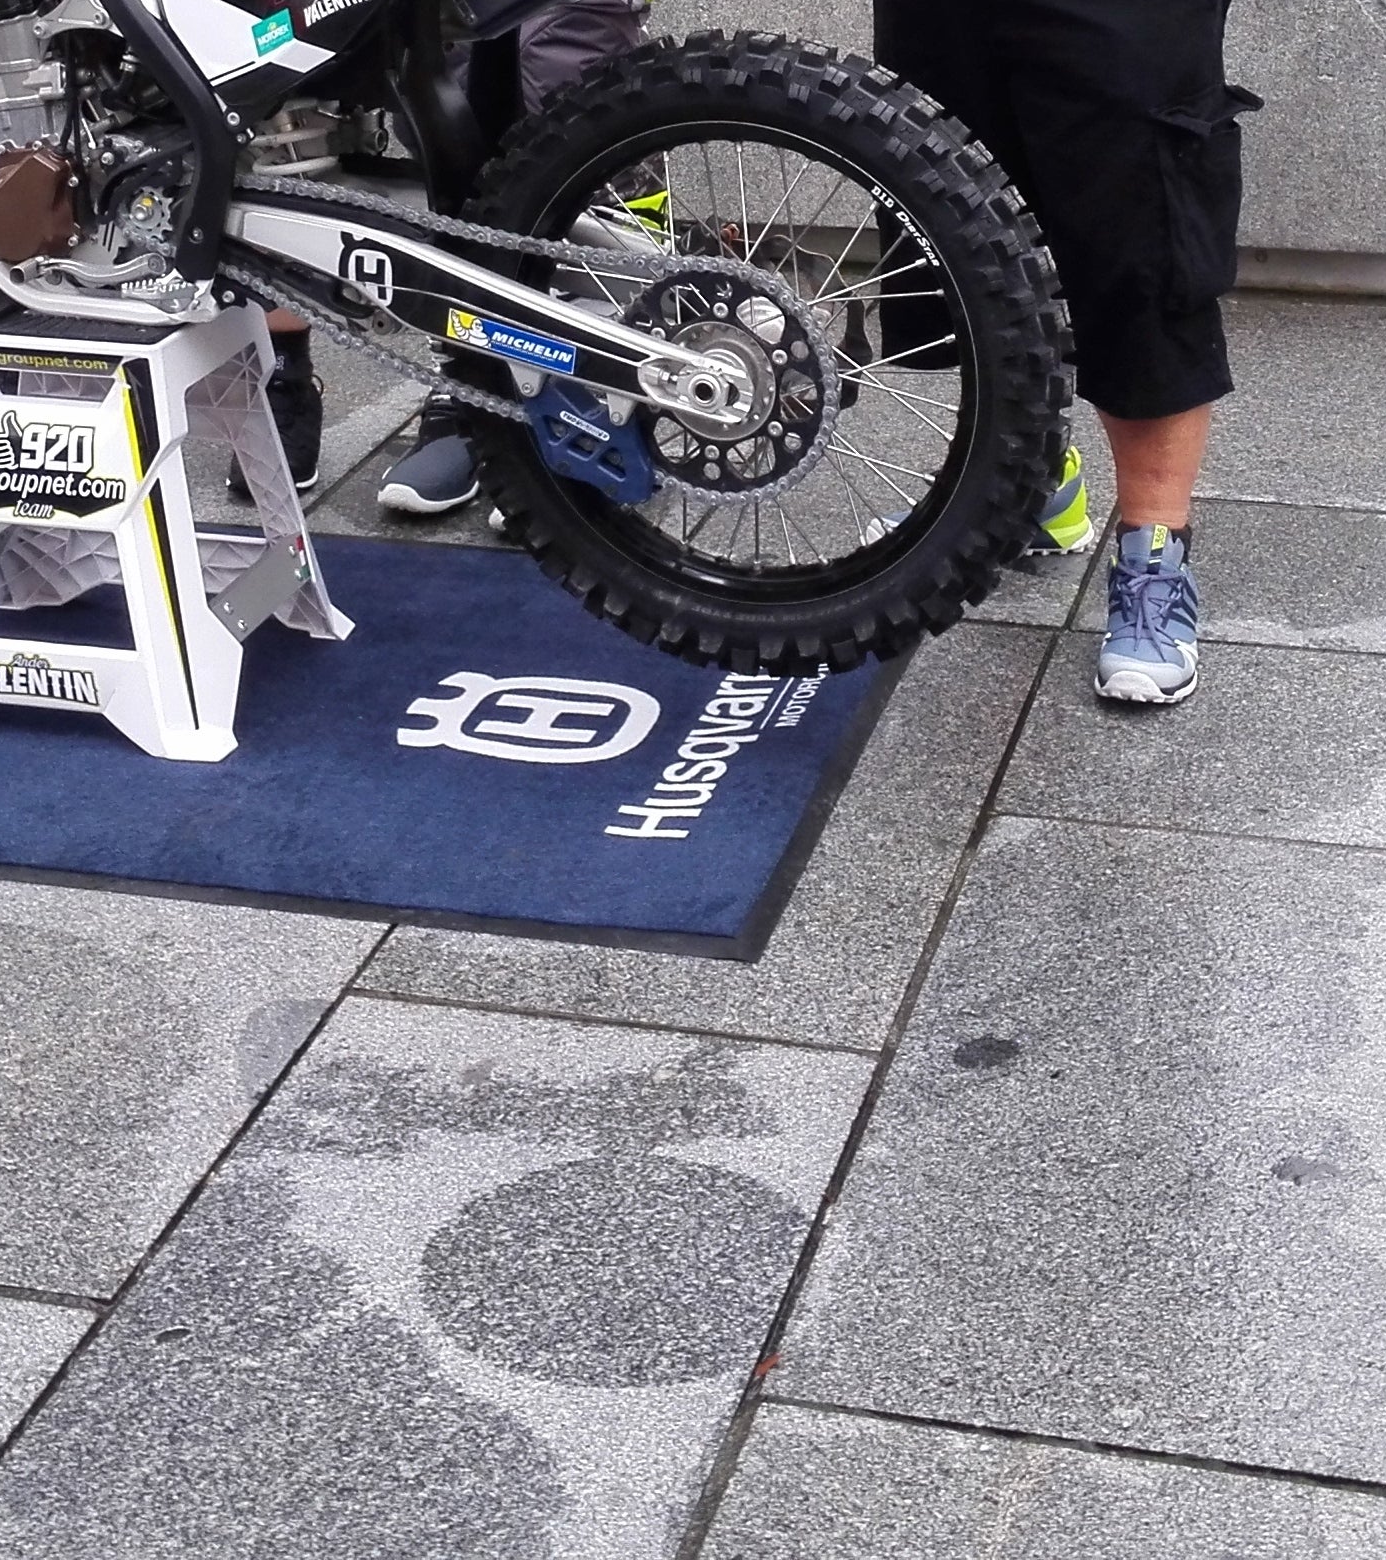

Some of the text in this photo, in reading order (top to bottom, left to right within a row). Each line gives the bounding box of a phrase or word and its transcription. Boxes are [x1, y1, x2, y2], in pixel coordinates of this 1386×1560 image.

[491, 330, 573, 364] MICHELIN
[19, 422, 95, 474] 920
[13, 499, 54, 519] team
[12, 654, 49, 669] Ander
